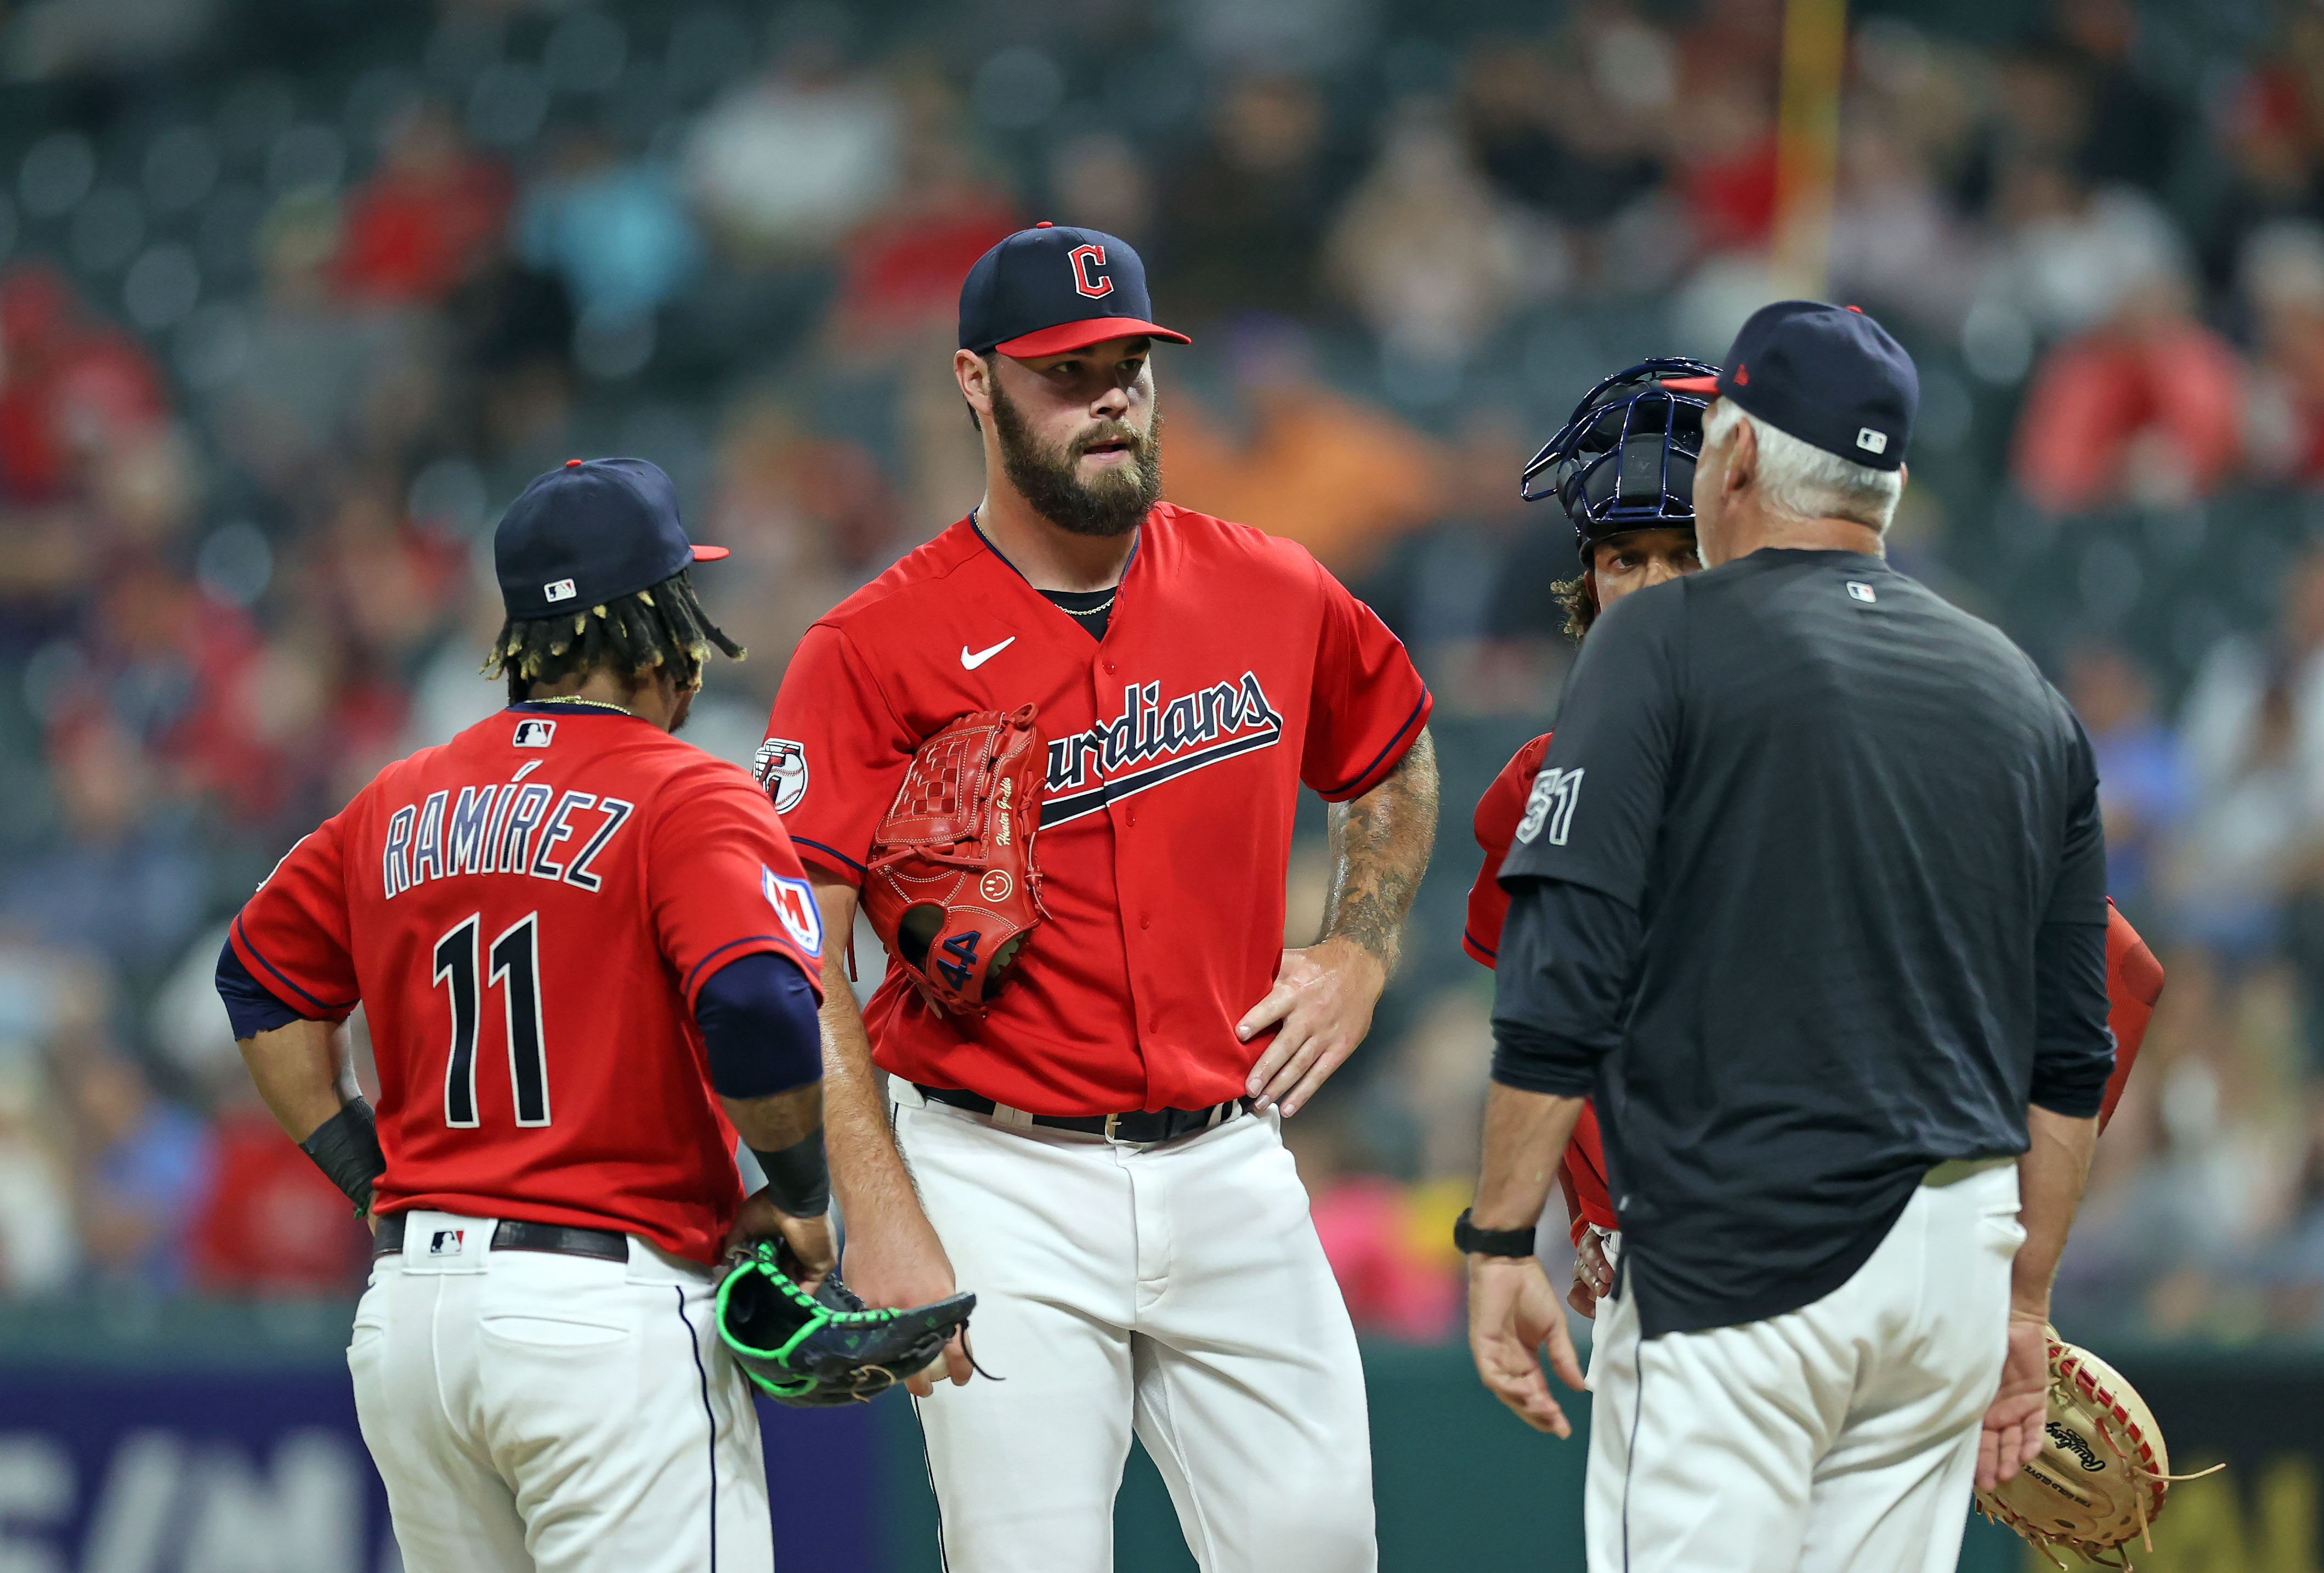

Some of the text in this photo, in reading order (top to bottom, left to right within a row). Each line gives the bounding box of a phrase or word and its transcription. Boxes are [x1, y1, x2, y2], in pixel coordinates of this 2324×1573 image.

[1068, 244, 1114, 299] C
[1044, 671, 1284, 793] ardians
[383, 759, 635, 900] RAMÍREZ
[995, 812, 1011, 846] Hunter
[1515, 767, 1585, 846] 51
[937, 930, 982, 992] 44
[433, 910, 552, 1128] 11
[2045, 1422, 2106, 1472] Rawling
